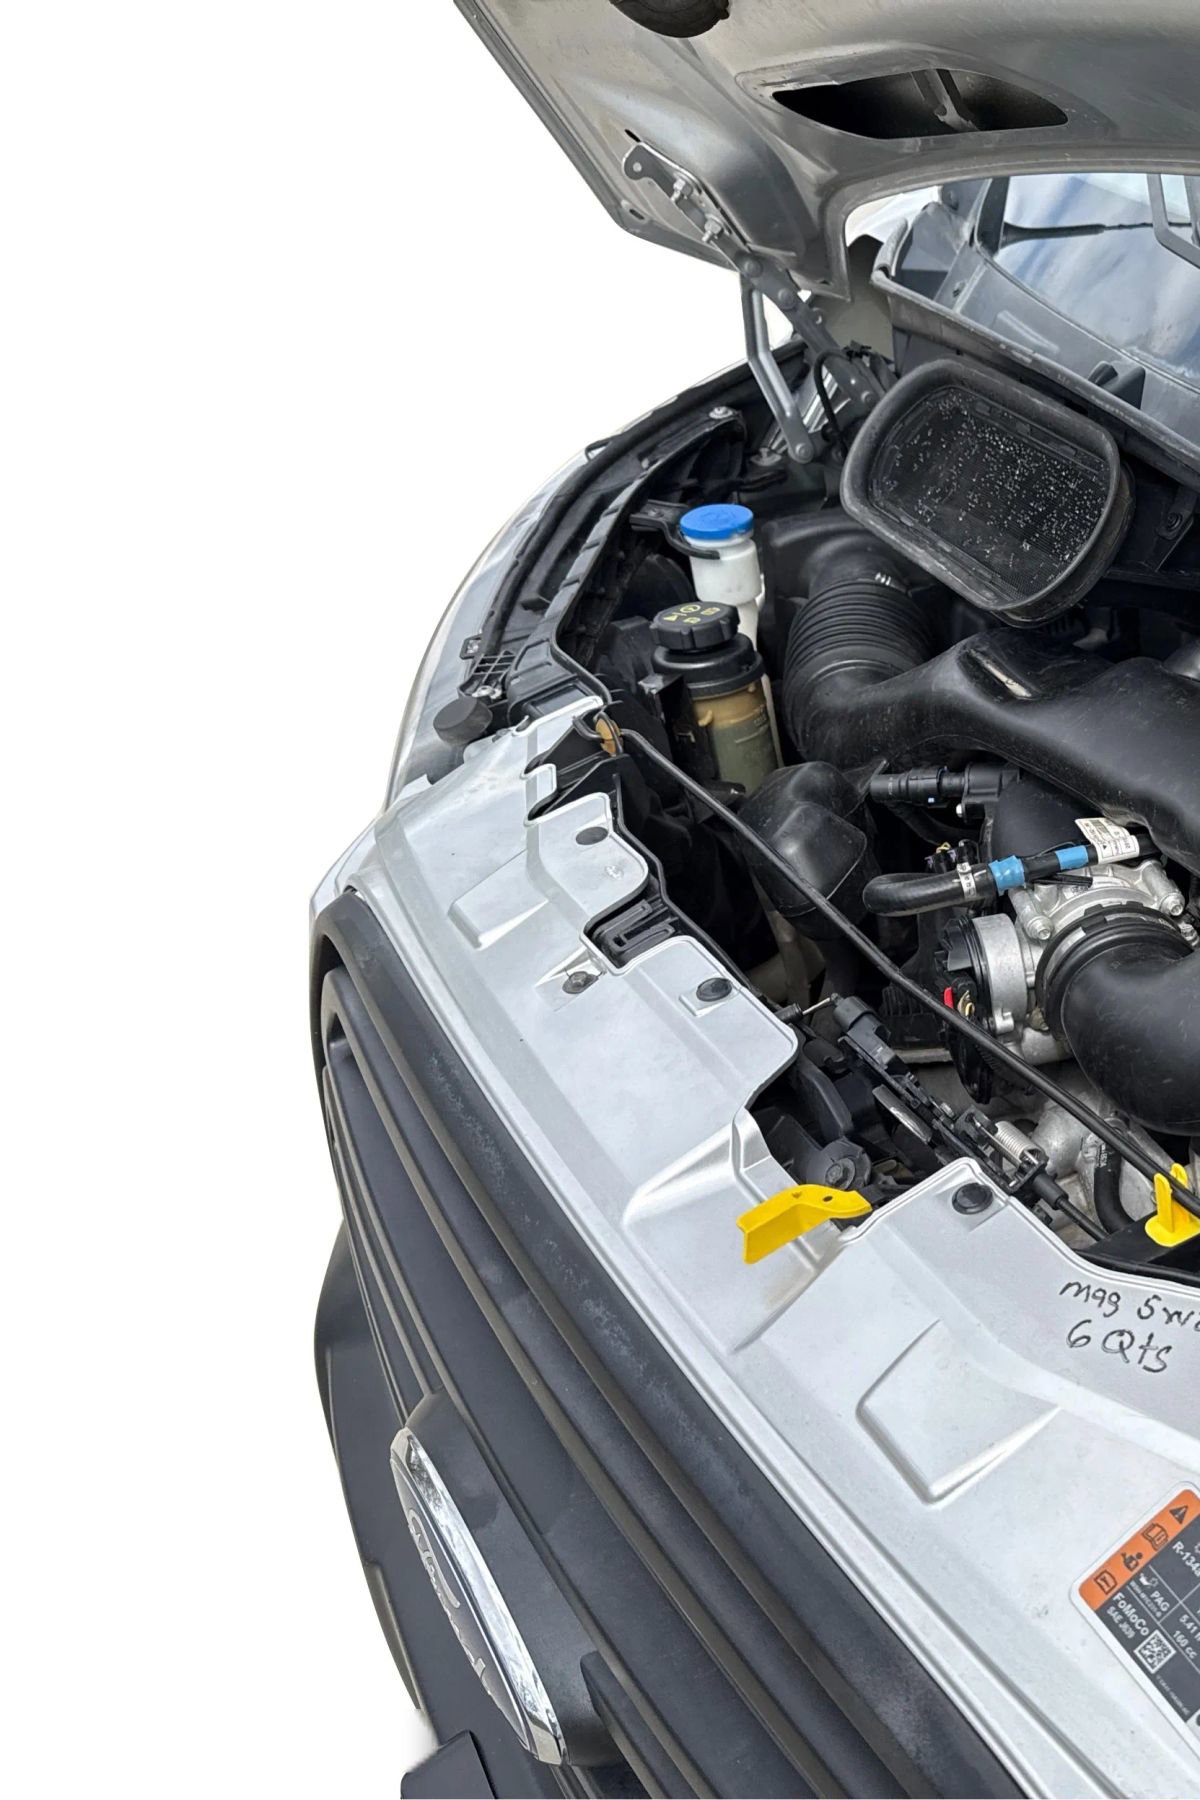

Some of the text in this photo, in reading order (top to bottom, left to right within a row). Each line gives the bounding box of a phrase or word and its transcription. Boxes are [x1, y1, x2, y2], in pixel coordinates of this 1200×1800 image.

[1066, 1319, 1092, 1348] 6
[1149, 1589, 1170, 1612] PAG
[1106, 1605, 1122, 1623] SAE
[1111, 1591, 1152, 1637] FoMoCo
[1179, 1613, 1198, 1633] 5.41
[1171, 1629, 1197, 1659] 160 cc
